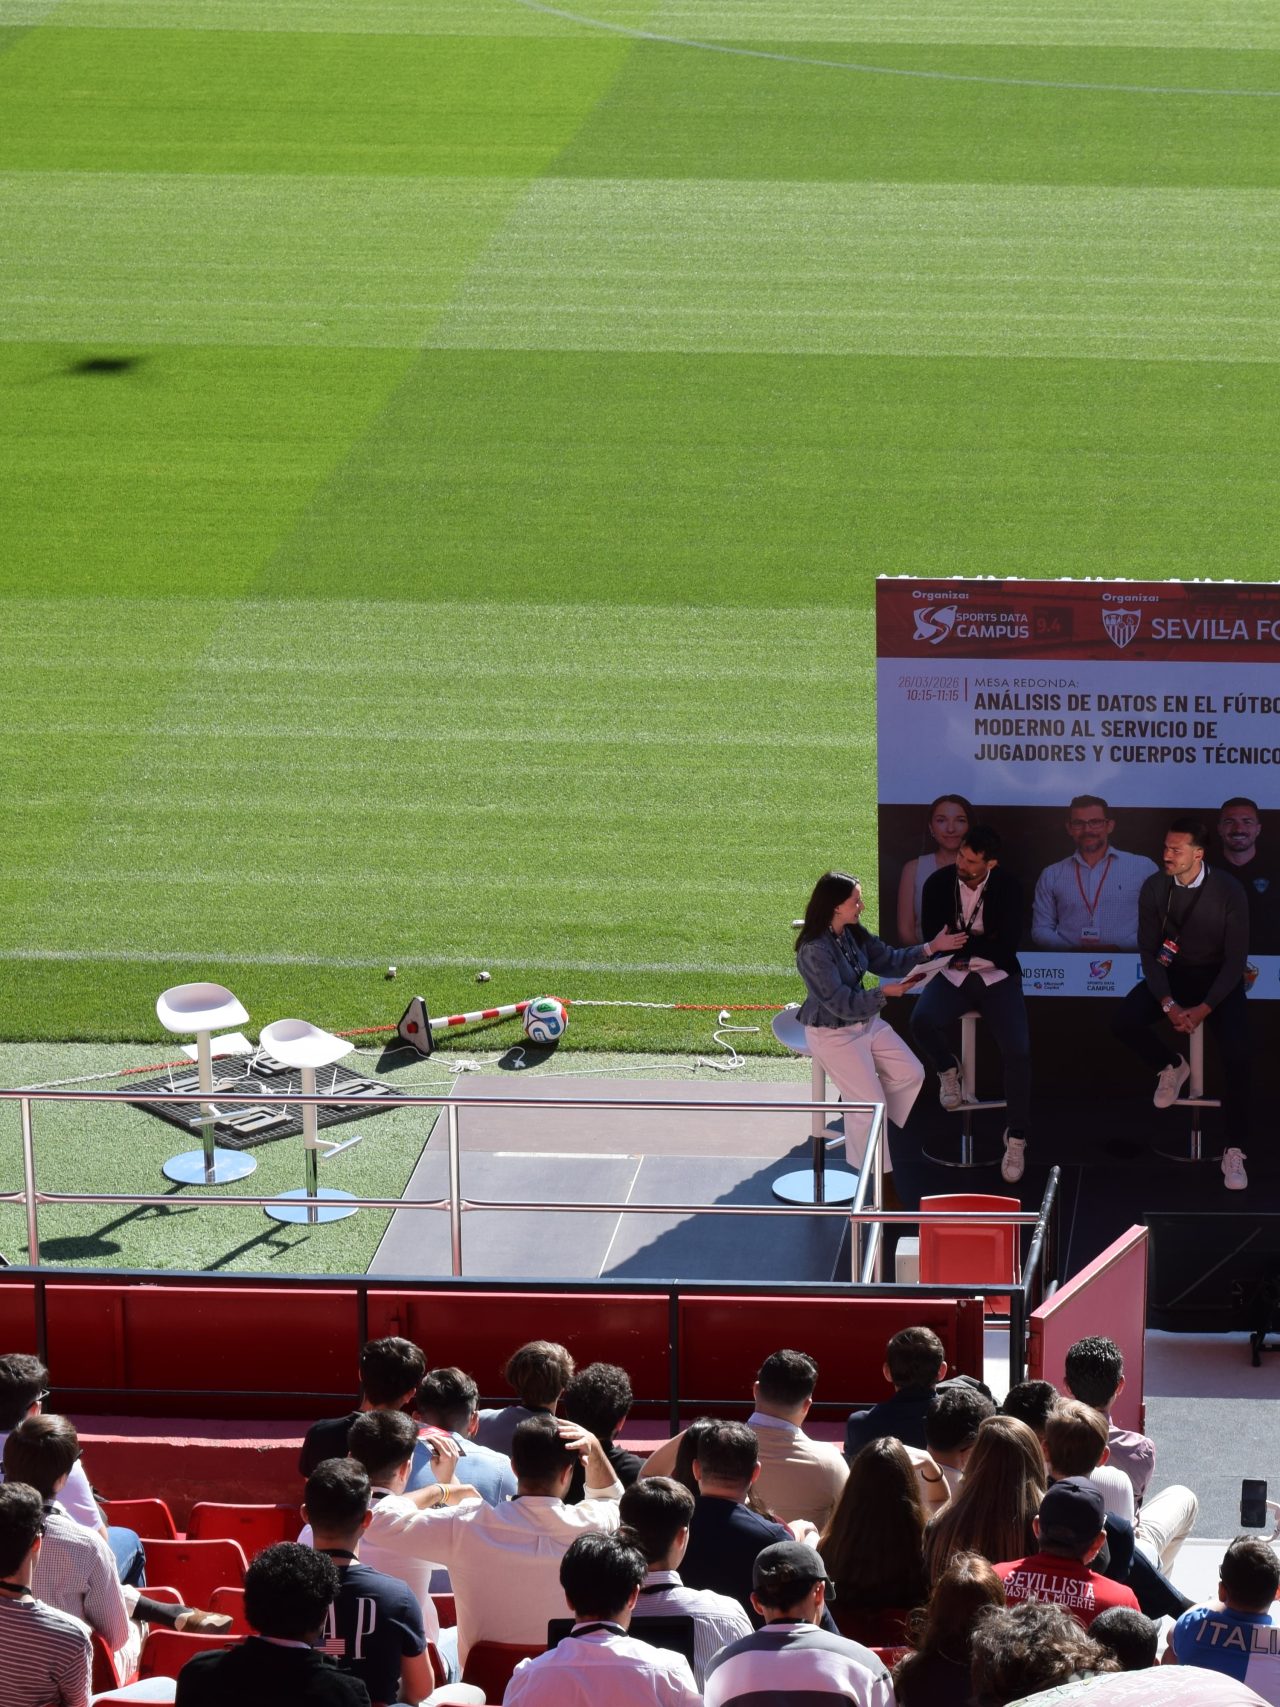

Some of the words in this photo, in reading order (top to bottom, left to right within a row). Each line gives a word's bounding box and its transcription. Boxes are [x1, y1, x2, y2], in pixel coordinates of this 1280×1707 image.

[912, 590, 969, 601] Organiza:
[1102, 593, 1159, 604] Organiza:
[956, 613, 997, 622] SPORTS
[1000, 613, 1028, 622] DATA
[956, 624, 1029, 639] CAMPUS
[1151, 617, 1249, 640] SEVILLA
[898, 676, 959, 688] 26/03/2026
[974, 678, 1009, 688] MESA
[1013, 679, 1080, 689] REDONDA:
[907, 689, 959, 701] 10:15-11:15
[974, 690, 1061, 711] ANÁLISIS
[1068, 694, 1092, 711] DE
[1097, 694, 1157, 712] DATOS
[1163, 695, 1188, 713] EN
[1195, 696, 1217, 713] EL
[974, 718, 1065, 737] MODERNO
[1071, 719, 1095, 737] AL
[1101, 720, 1187, 738] SERVICIO
[1193, 721, 1218, 739] DE
[974, 743, 1086, 762] JUGADORES
[1093, 745, 1104, 762] Y
[1110, 745, 1197, 763] CUERPOS
[1034, 968, 1065, 979] STATS
[1004, 1570, 1095, 1599] SEVILLISTA
[1004, 1584, 1031, 1599] HASTA
[1053, 1593, 1095, 1611] MUERTE
